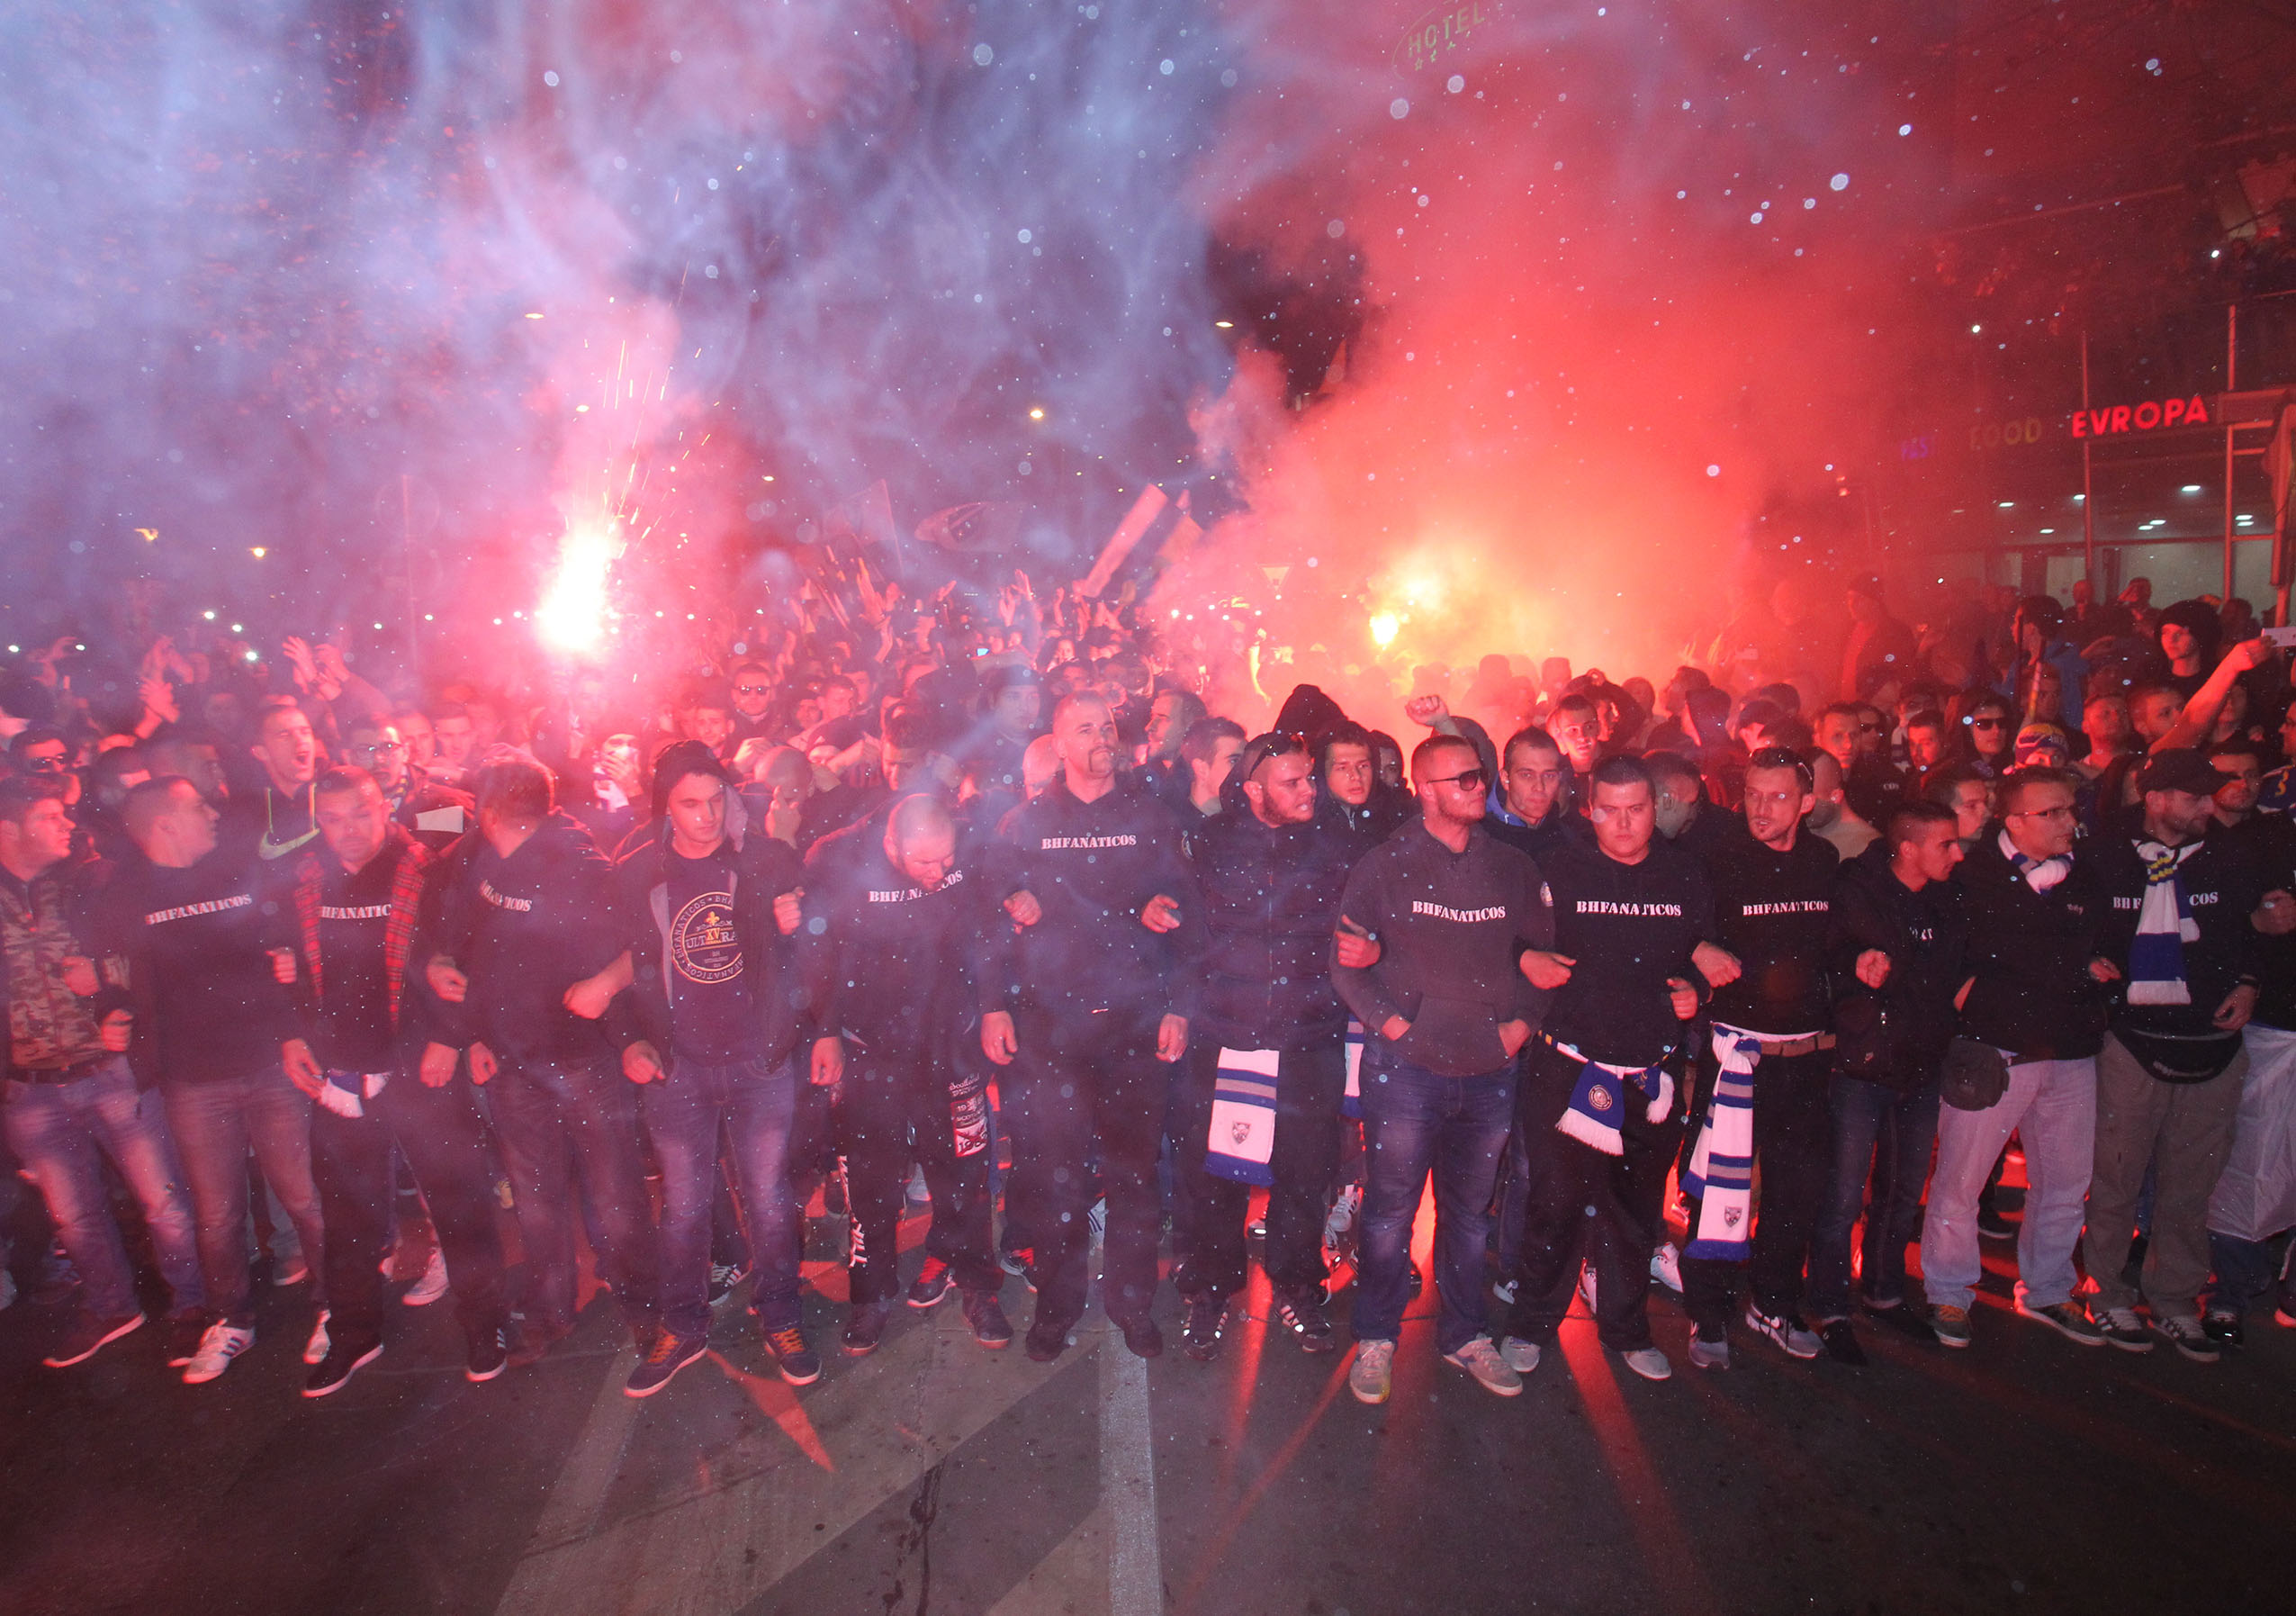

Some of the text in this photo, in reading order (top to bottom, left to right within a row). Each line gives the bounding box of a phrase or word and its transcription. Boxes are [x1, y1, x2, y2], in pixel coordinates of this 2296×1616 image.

[1408, 1, 1486, 59] HOTEL
[1970, 416, 2042, 451] FOOD
[2072, 395, 2209, 438] EVROPA
[1041, 835, 1137, 849] BHFANATICOS
[145, 893, 252, 925] BHFANATICOS
[1412, 900, 1507, 923] BHFANATICOS
[1576, 900, 1682, 916] BHFANATICOS
[1742, 900, 1829, 916] BHFANATICOS
